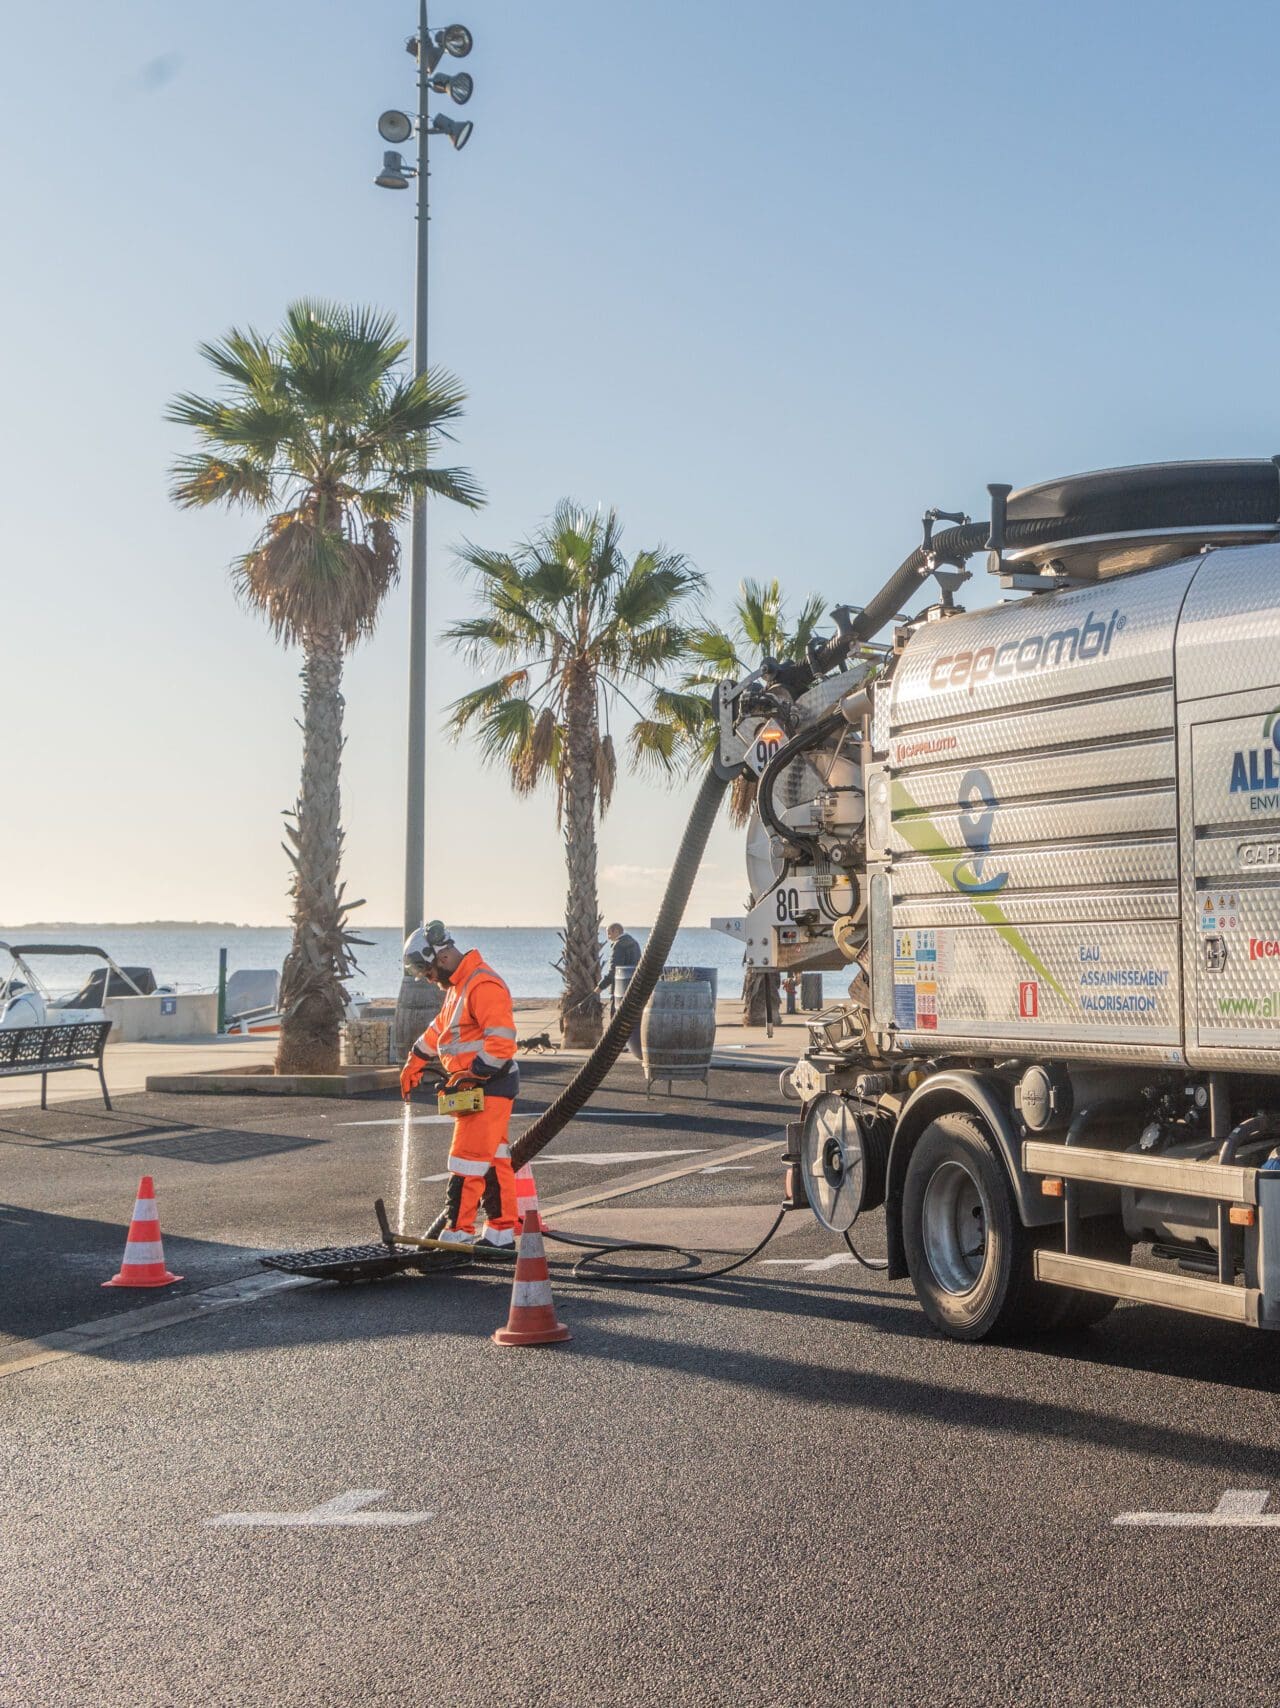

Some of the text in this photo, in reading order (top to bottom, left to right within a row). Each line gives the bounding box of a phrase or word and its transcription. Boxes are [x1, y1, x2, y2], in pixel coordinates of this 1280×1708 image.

[776, 888, 799, 921] 80
[1080, 945, 1100, 962] EAU
[1080, 970, 1169, 986] ASSAINISSEMENT
[1080, 995, 1155, 1011] VALORISATION
